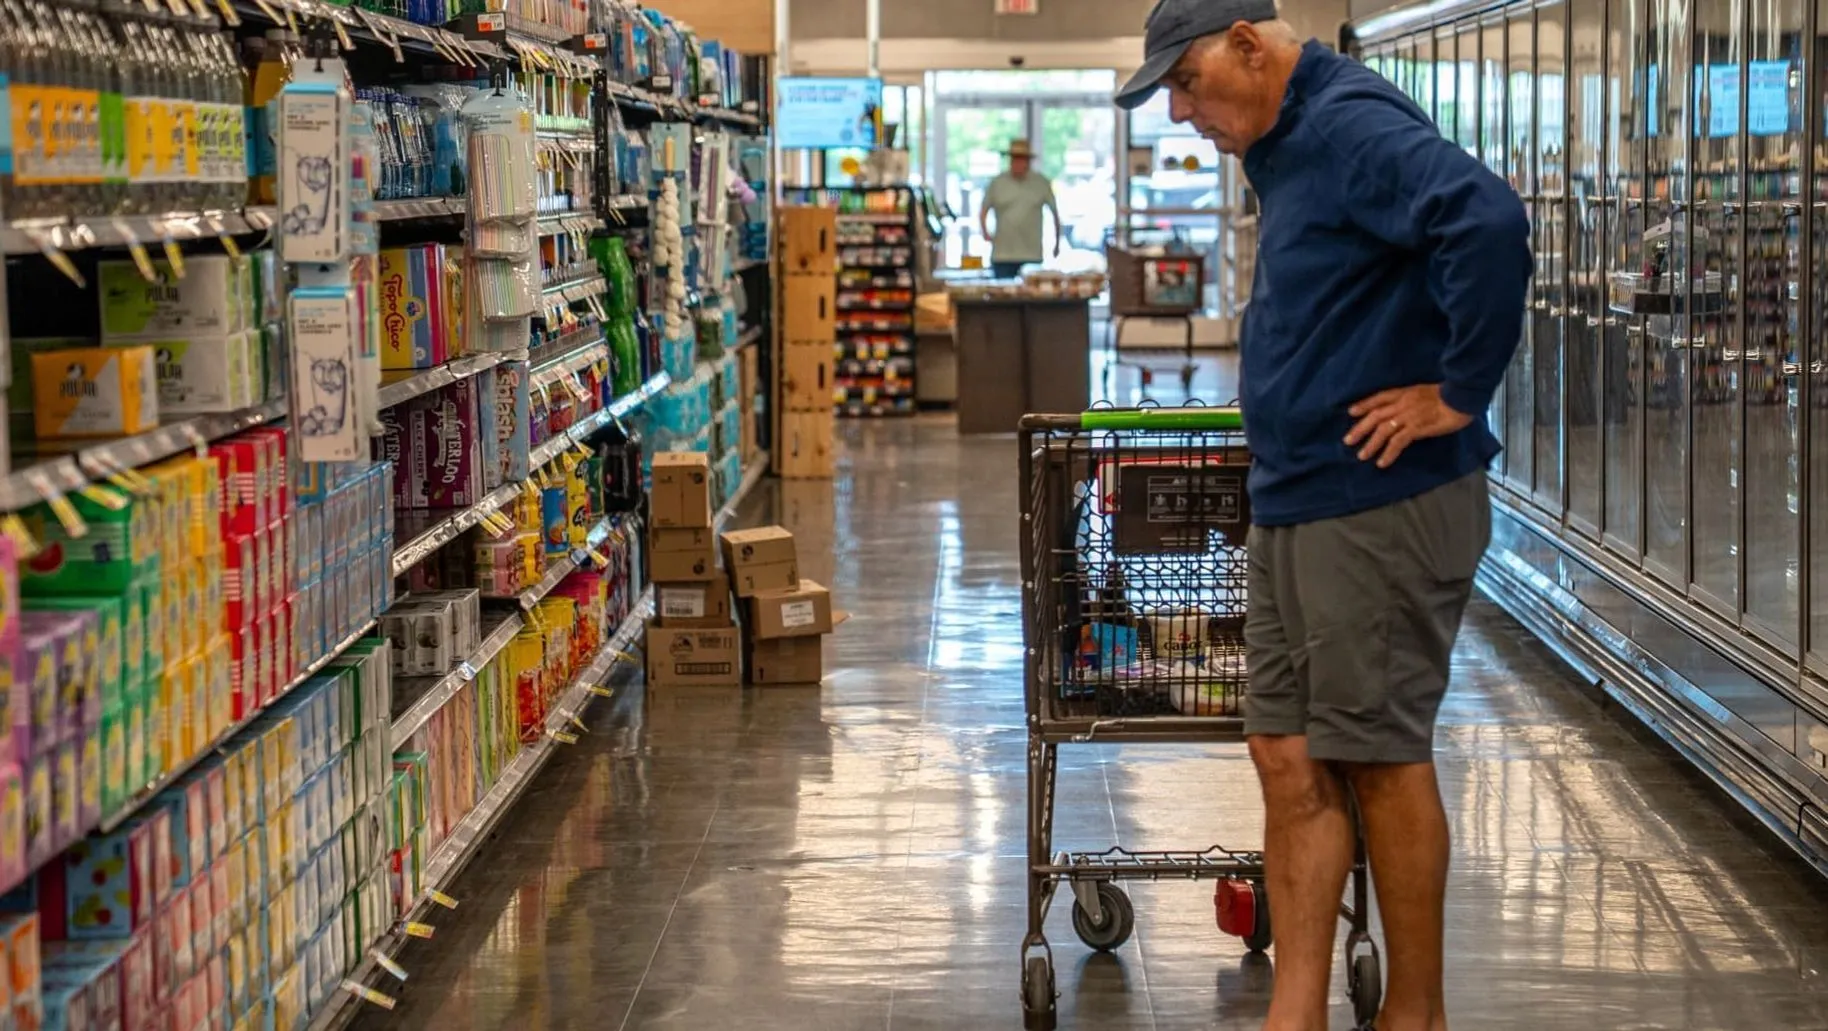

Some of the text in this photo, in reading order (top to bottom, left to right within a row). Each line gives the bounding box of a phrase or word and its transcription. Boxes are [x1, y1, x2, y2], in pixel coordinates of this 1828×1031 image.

[383, 273, 405, 352] Topo Chico
[154, 362, 183, 380] OLAR
[414, 412, 424, 479] BLACK CHERRY
